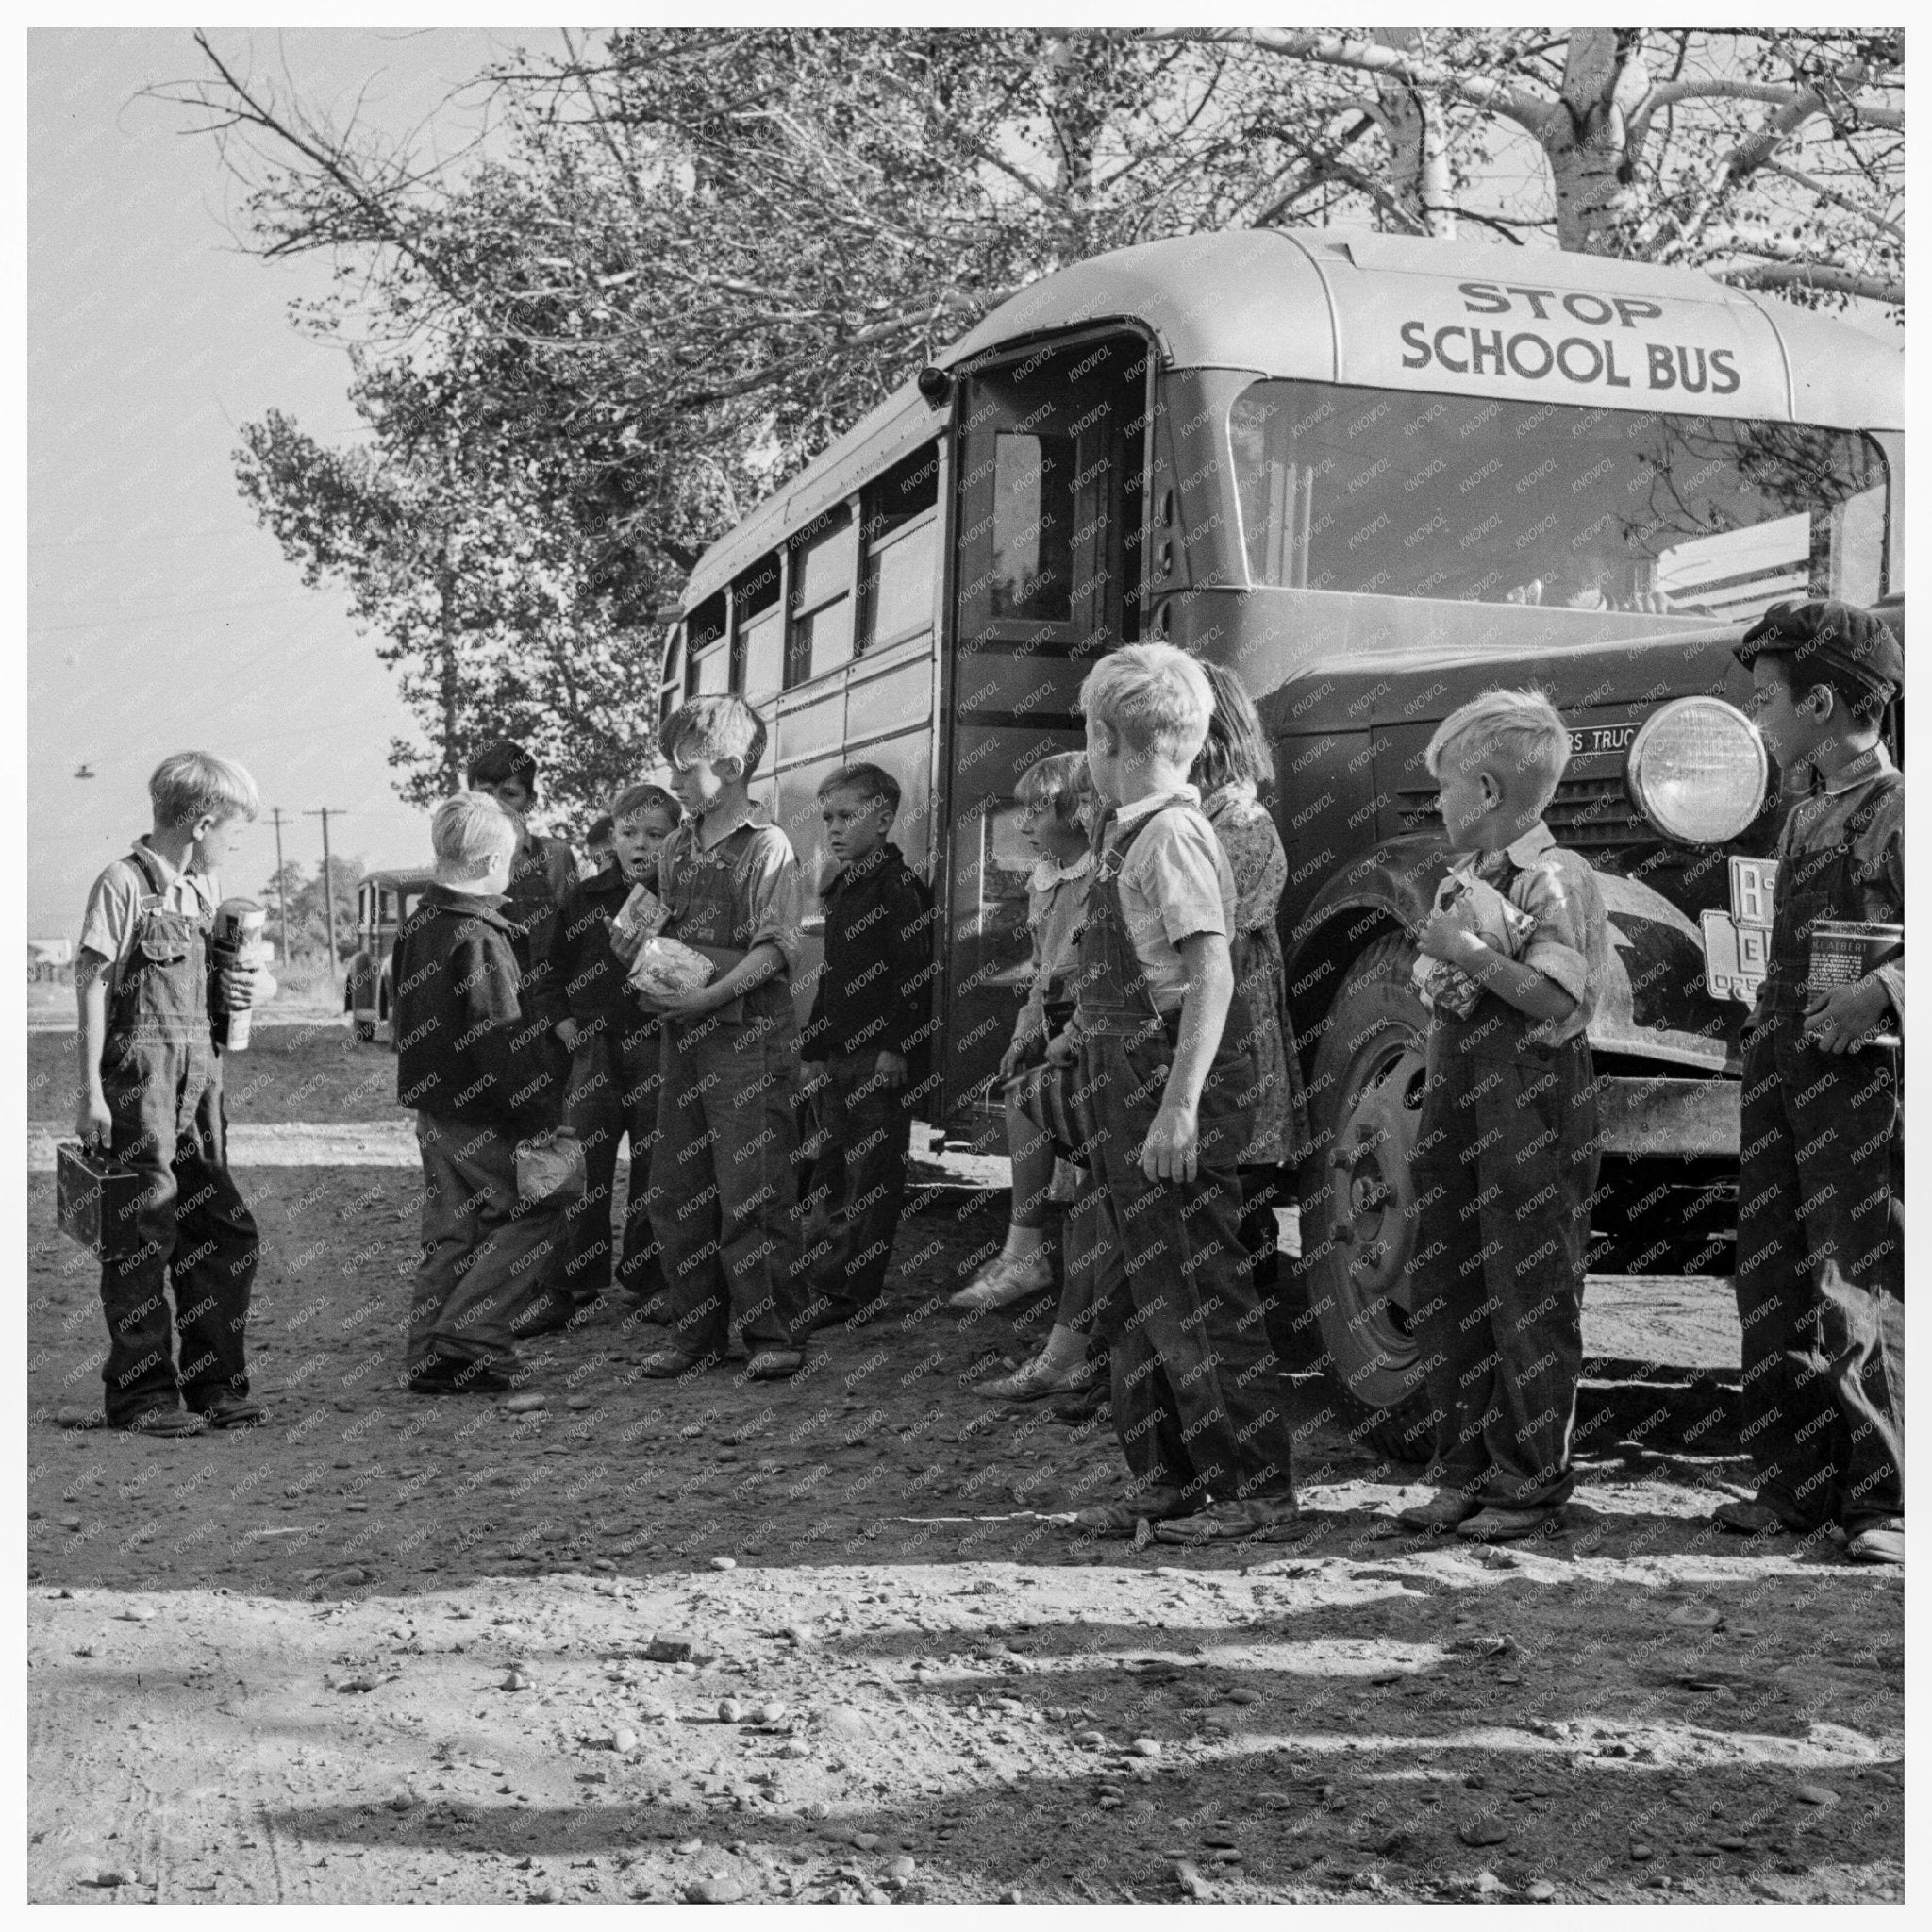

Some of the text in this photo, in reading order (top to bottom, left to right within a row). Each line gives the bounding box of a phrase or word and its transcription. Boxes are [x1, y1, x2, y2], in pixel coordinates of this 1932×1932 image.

[1457, 282, 1663, 327] STOP
[1401, 321, 1741, 394] SCHOOL BUS
